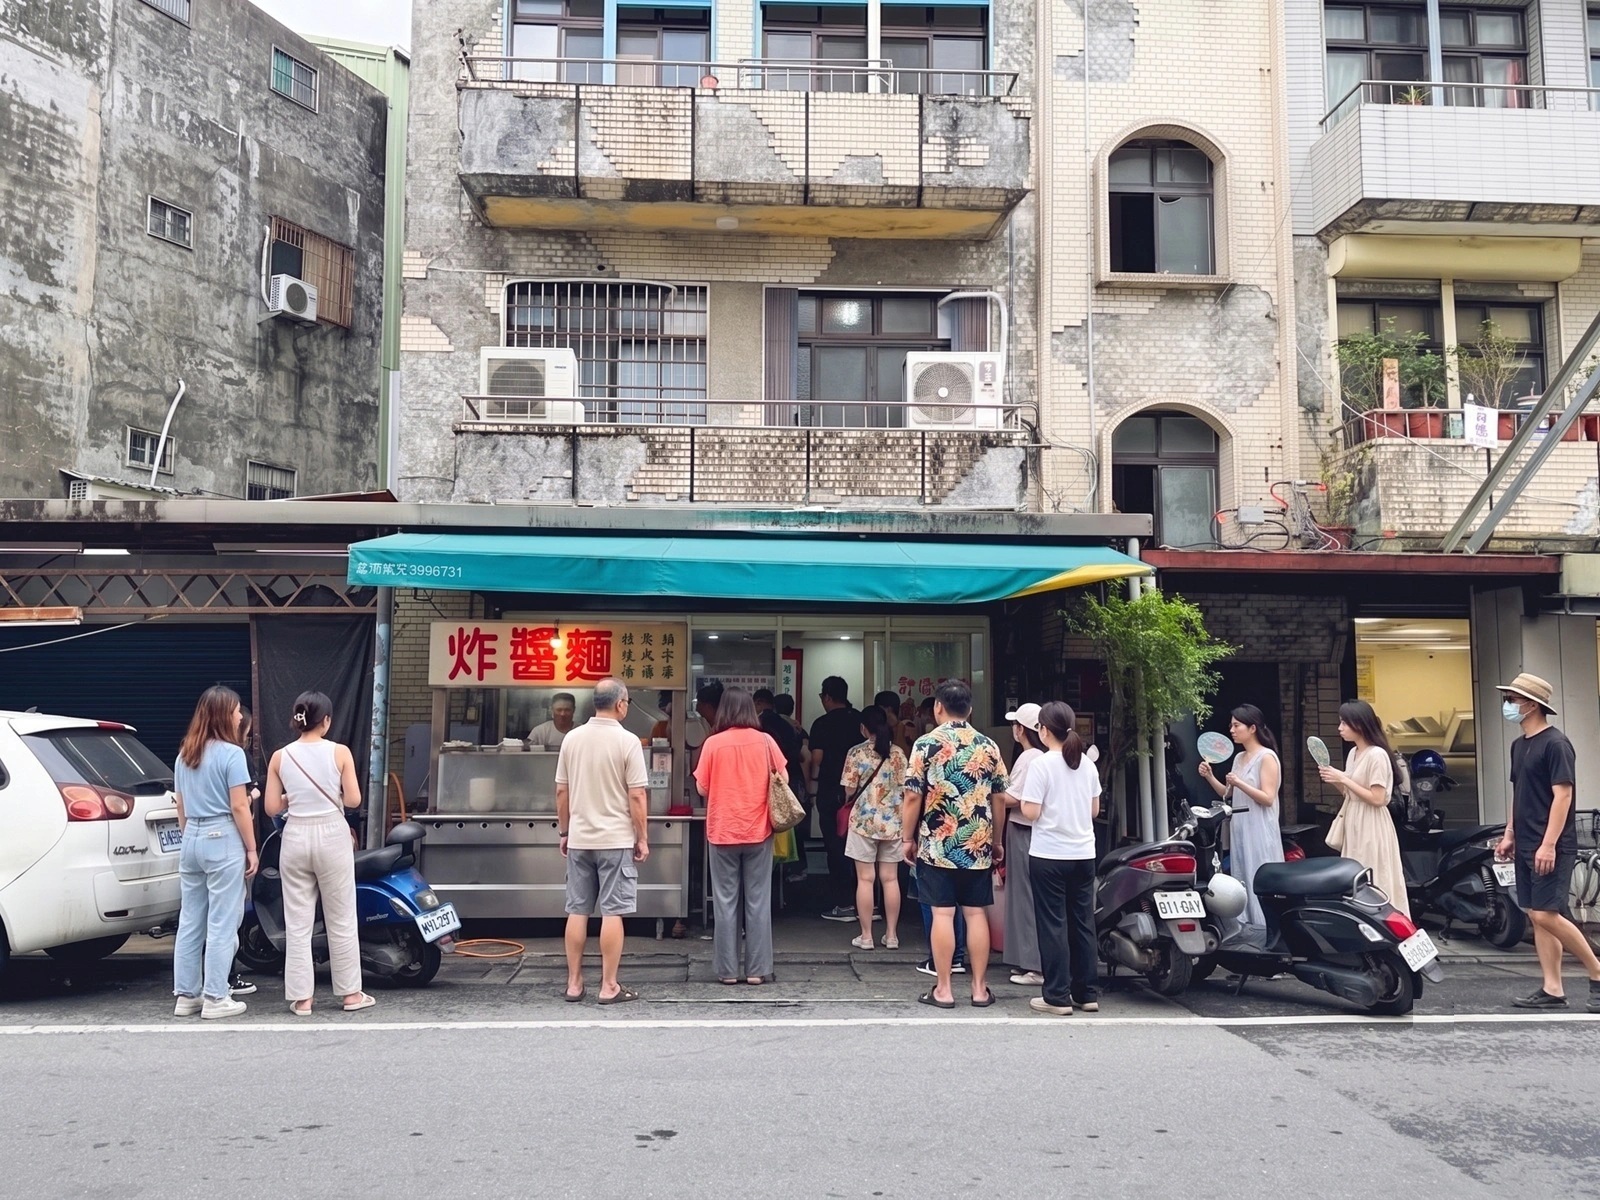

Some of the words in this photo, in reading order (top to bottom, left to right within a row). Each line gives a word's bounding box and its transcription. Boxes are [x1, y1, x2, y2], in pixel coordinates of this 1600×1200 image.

[409, 564, 462, 578] 3996731
[448, 627, 613, 682] 炸醬麵
